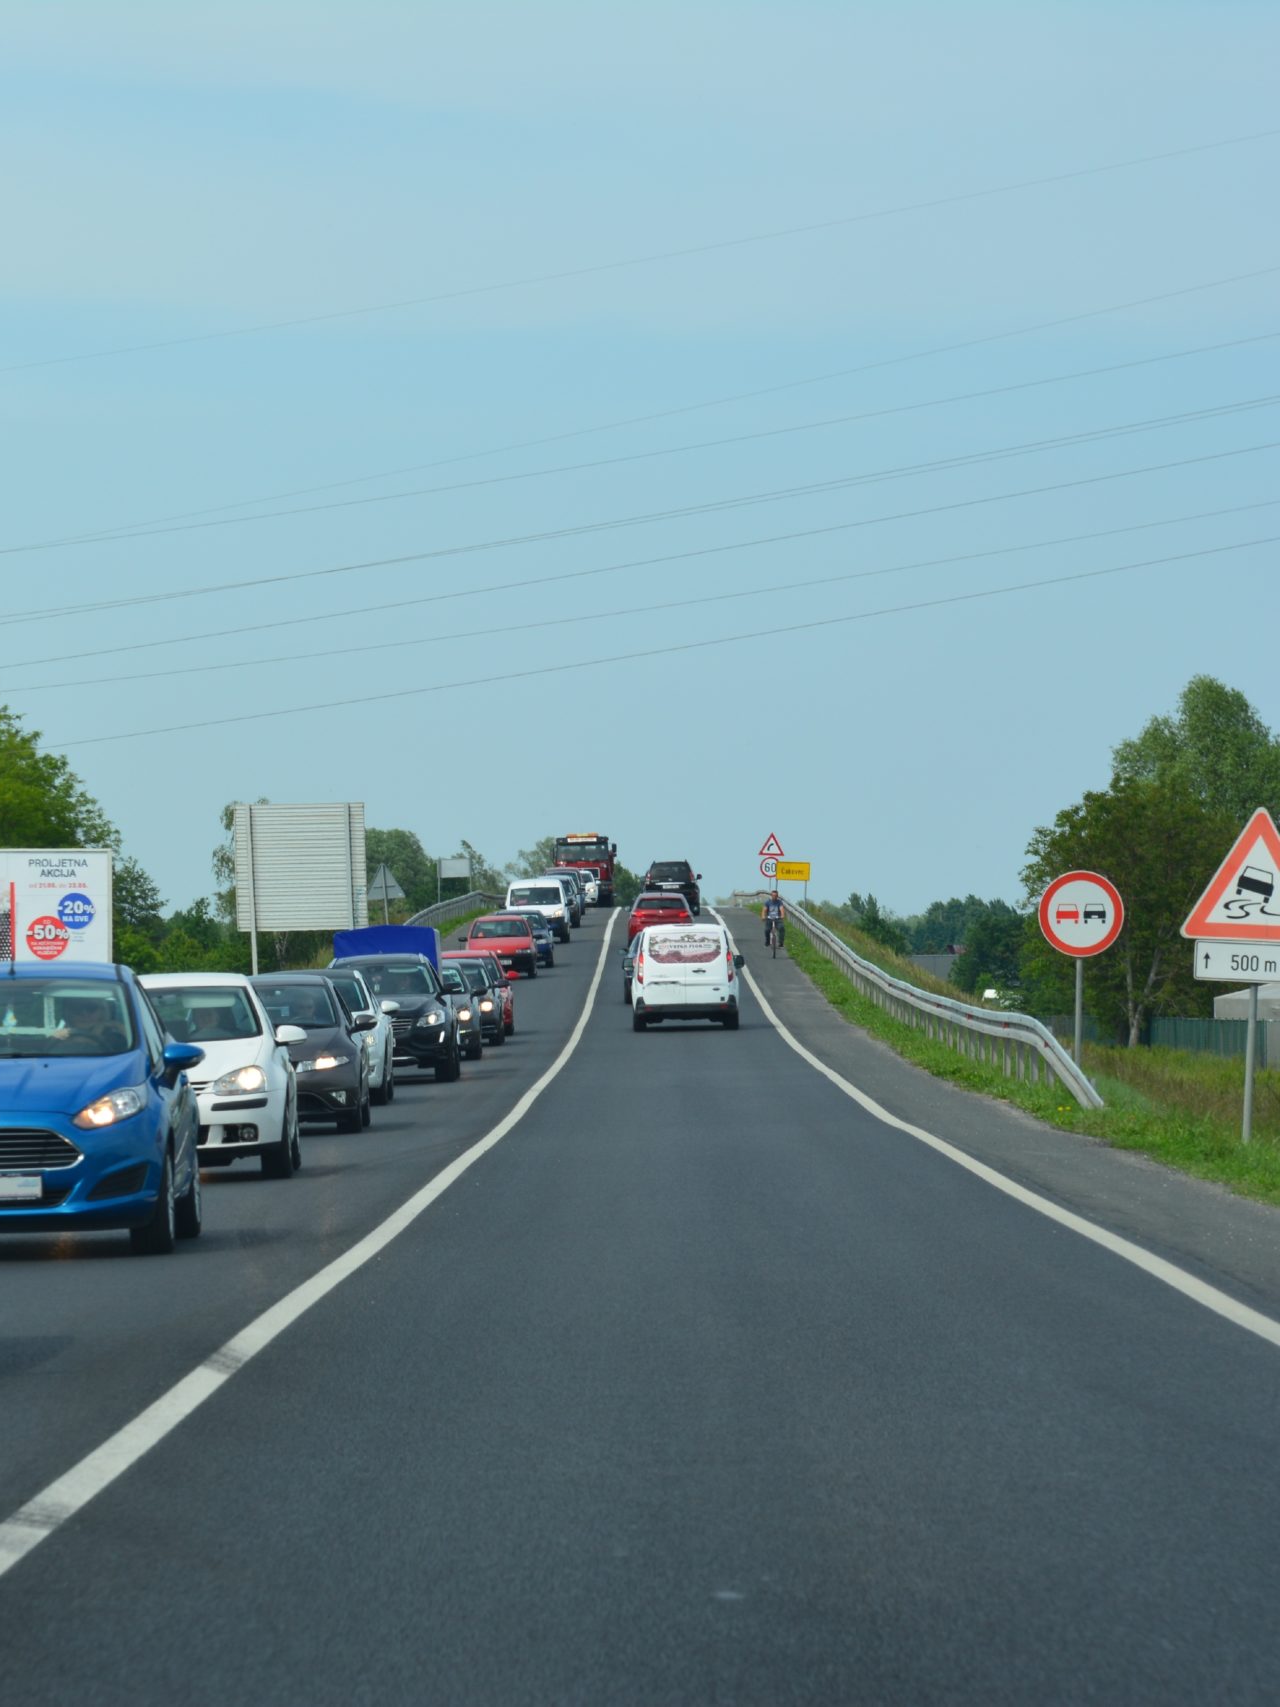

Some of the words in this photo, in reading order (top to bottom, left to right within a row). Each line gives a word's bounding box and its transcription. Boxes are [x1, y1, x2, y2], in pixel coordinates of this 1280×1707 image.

[28, 859, 88, 867] PROLJETNA
[764, 862, 776, 872] 60
[40, 869, 76, 877] AKCIJA
[58, 901, 96, 914] -20%
[27, 924, 70, 940] -50%
[1231, 955, 1259, 972] 500
[1264, 960, 1277, 973] m
